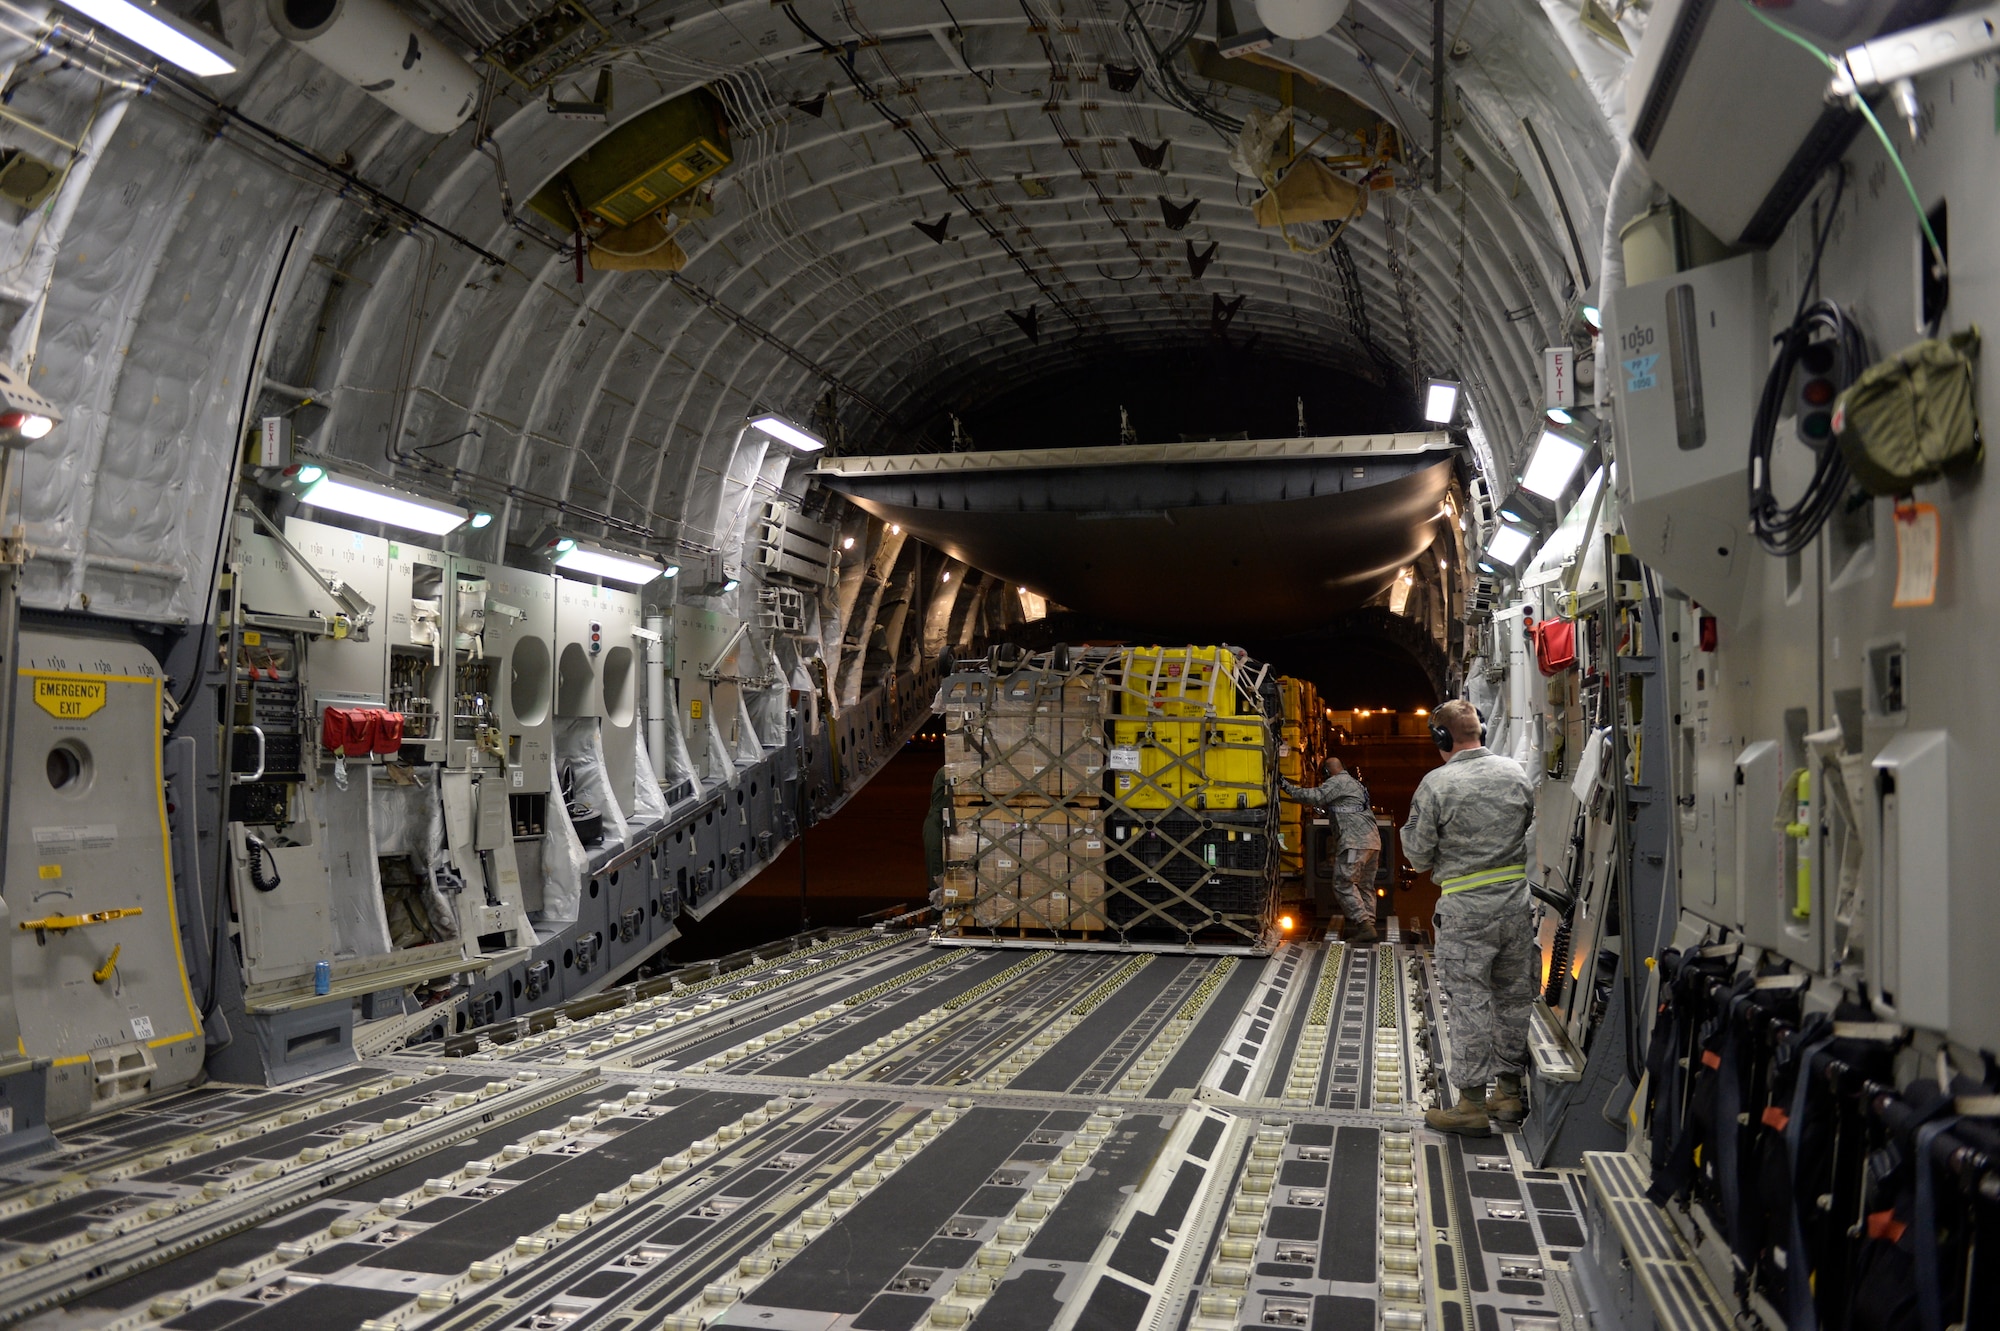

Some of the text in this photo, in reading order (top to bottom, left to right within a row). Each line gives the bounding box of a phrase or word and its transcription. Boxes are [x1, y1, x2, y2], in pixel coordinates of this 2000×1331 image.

[1227, 42, 1262, 57] EXIT
[1621, 327, 1654, 351] 1050
[1555, 353, 1564, 401] EXIT
[1632, 376, 1651, 390] 1050
[267, 422, 275, 461] EXIT
[310, 544, 323, 555] 1160
[238, 553, 252, 564] 1140
[343, 551, 355, 562] 1170
[427, 553, 437, 562] 1200
[275, 560, 288, 571] 1150
[47, 658, 66, 669] 1110
[94, 662, 112, 673] 1120
[138, 665, 155, 676] 1130
[40, 683, 100, 698] EMERGENCY
[60, 702, 82, 715] EXIT
[138, 1028, 151, 1039] 1120
